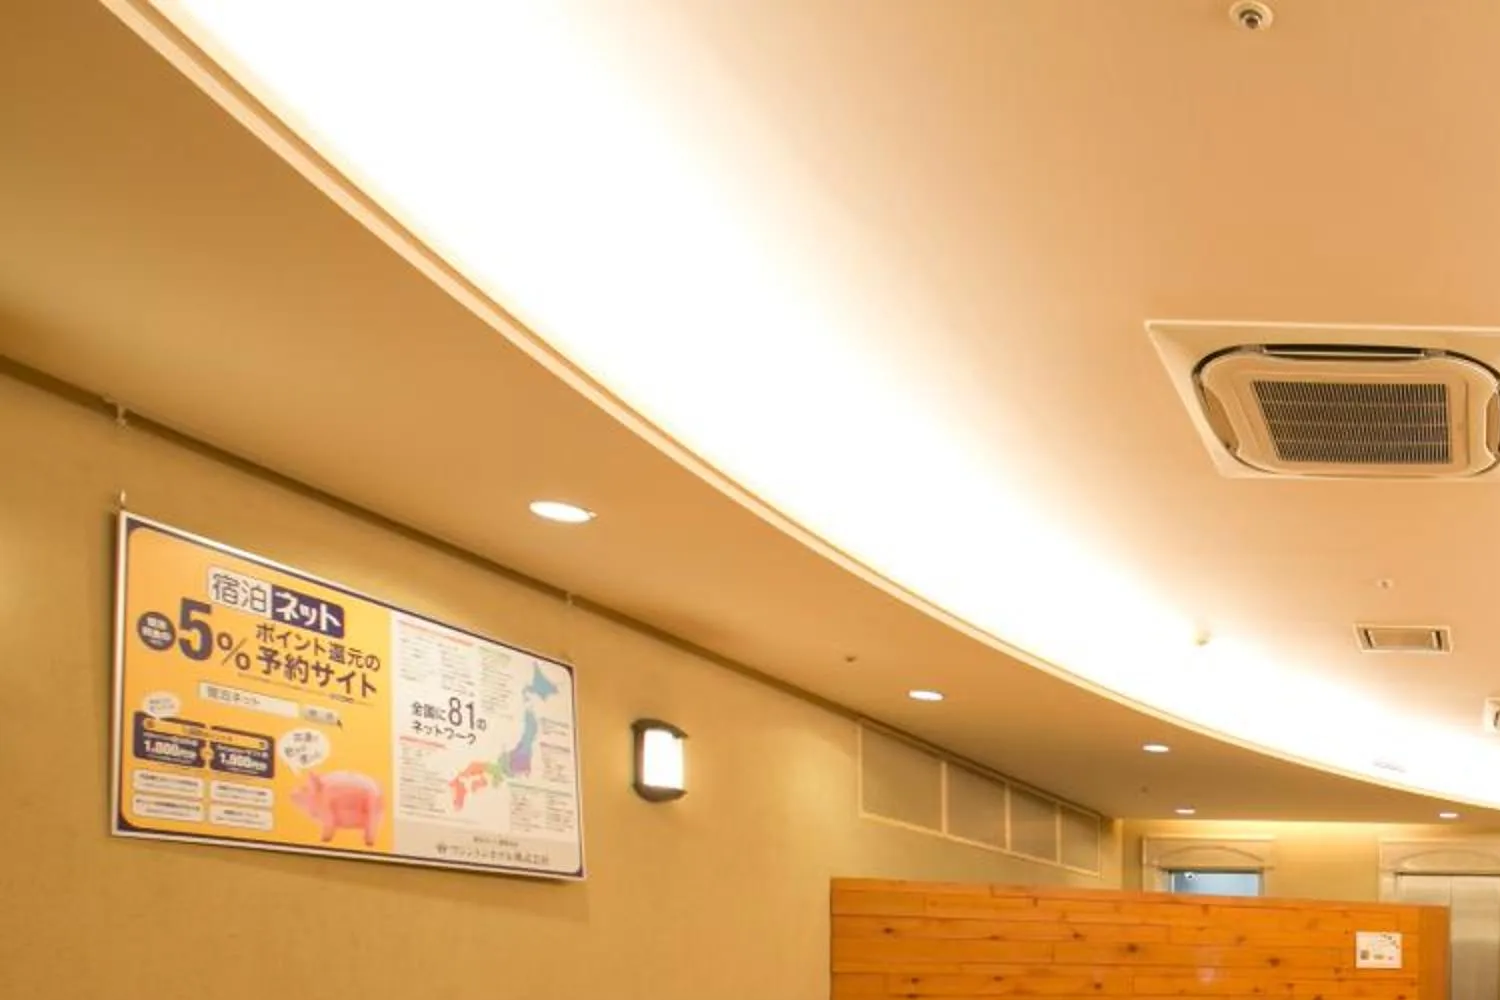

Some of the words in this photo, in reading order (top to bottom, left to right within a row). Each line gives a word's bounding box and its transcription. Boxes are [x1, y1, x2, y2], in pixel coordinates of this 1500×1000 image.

[212, 572, 342, 632] 宿泊ネット
[256, 623, 381, 671] ポイント還元の
[256, 646, 377, 698] 予約サイト
[411, 720, 477, 745] ネットワーク
